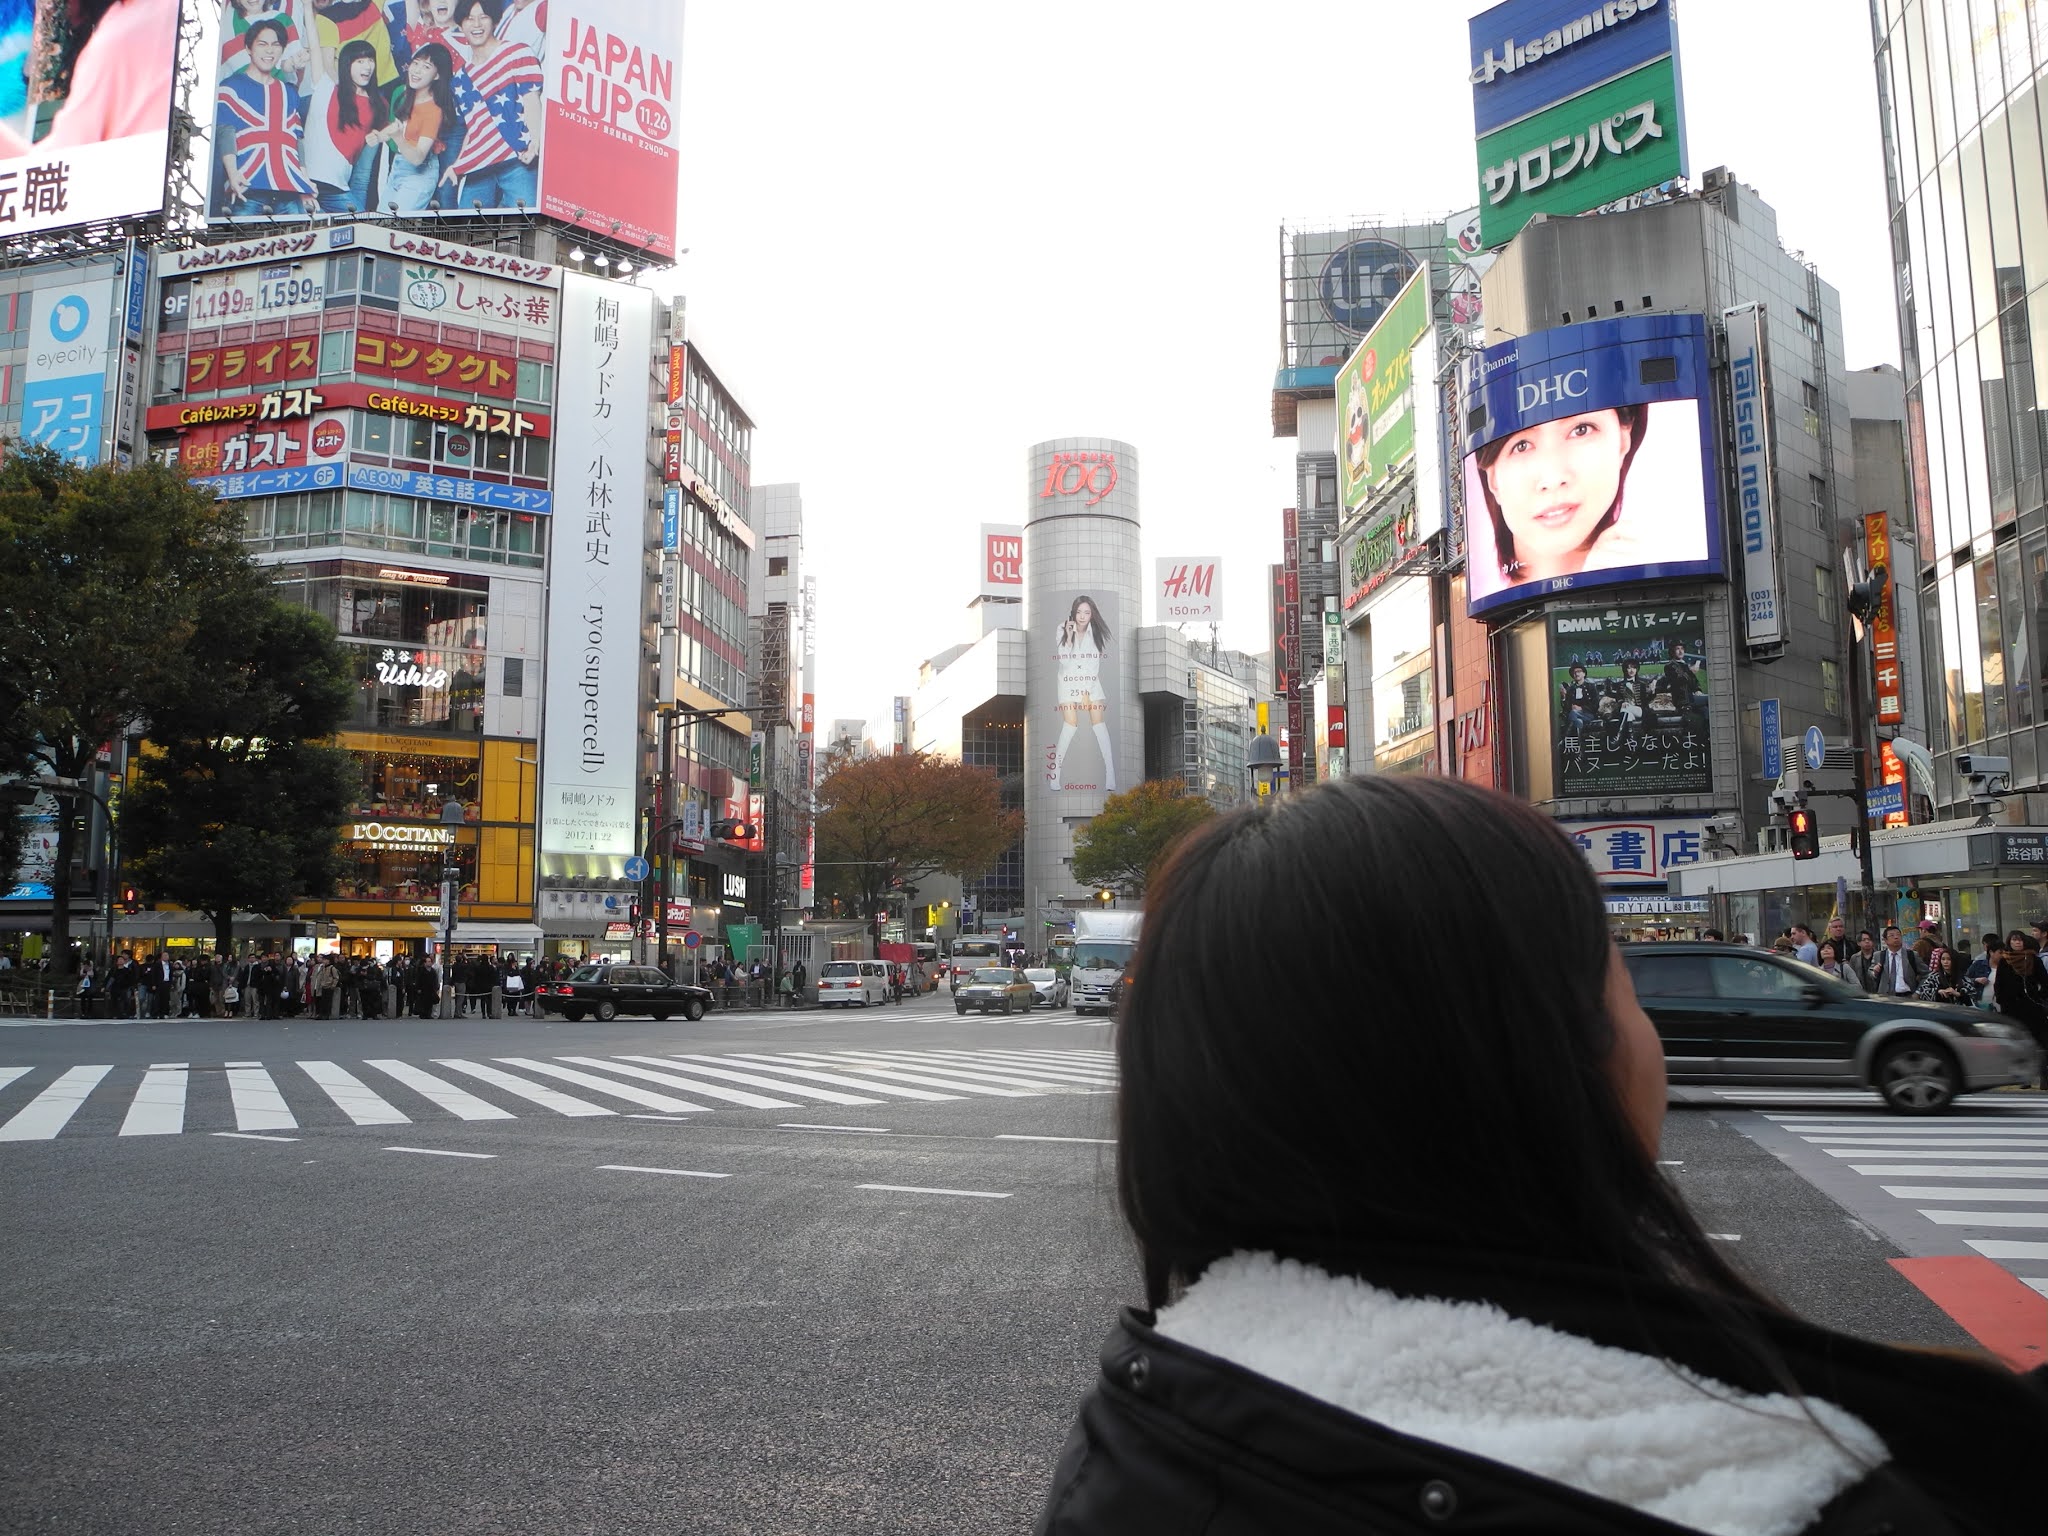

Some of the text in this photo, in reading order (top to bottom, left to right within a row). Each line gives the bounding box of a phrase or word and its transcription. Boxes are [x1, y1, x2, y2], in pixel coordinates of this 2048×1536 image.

[562, 17, 673, 102] JAPAN
[560, 65, 633, 126] CUP
[559, 108, 599, 130] ジャパンカップ
[638, 139, 669, 158] 芝2400m
[639, 106, 668, 132] 11.26
[1482, 99, 1663, 205] サロンパス
[177, 230, 553, 282] しゃぶしゃぶバイキング 寿司 しゃぶしゃぶバイキング
[164, 294, 189, 315] 9F
[195, 278, 323, 323] 1,199円 1,599円
[456, 281, 550, 325] しゃぶ葉
[36, 344, 97, 370] eyecity
[189, 341, 315, 384] プライス
[356, 335, 512, 388] コンタクト
[592, 296, 620, 420] 桐嶋ノドカ
[1371, 327, 1424, 414] オッズパー
[1480, 348, 1519, 377] Channel
[122, 371, 135, 431] 献血ルーム
[260, 388, 323, 420] ガスト
[1517, 369, 1588, 413] DHC
[463, 404, 535, 438] ガスト
[186, 442, 220, 461] Café
[222, 431, 301, 473] ガスト
[315, 436, 343, 448] ガスト
[669, 443, 680, 474] ガスト
[316, 468, 333, 483] 6F
[356, 468, 548, 508] AEON 英会話イーオン
[1039, 460, 1118, 506] 109
[585, 454, 613, 566] 小林武史
[667, 494, 677, 547] 英会話イーオン
[1737, 466, 1762, 553] neon
[665, 566, 674, 622] 渋谷駅前ビル
[1163, 563, 1215, 598] H&M
[1551, 577, 1574, 589] DHC
[1751, 589, 1770, 603] (03)
[1169, 606, 1200, 616] 150m
[1557, 611, 1698, 633] DMM バヌーシー
[1750, 601, 1773, 613] 3719
[1750, 610, 1774, 622] 2468
[1080, 652, 1108, 660] amuro
[376, 661, 449, 688] Ushi8
[578, 604, 608, 774] ryo(supercell)
[1063, 674, 1097, 682] docomo
[1876, 641, 1899, 715] 三千里
[1053, 703, 1108, 712] anniversary
[1070, 689, 1090, 697] 25th
[803, 703, 813, 723] 免税
[1563, 731, 1706, 755] 馬主じゃないよ、
[752, 753, 760, 775] レイク
[1046, 743, 1057, 781] 1992
[561, 791, 615, 806] 桐嶋ノドカ
[389, 843, 439, 852] PROVENCE
[565, 830, 612, 841] 2017.11.22
[2007, 847, 2044, 861] 渋谷駅
[723, 873, 746, 898] LUSH
